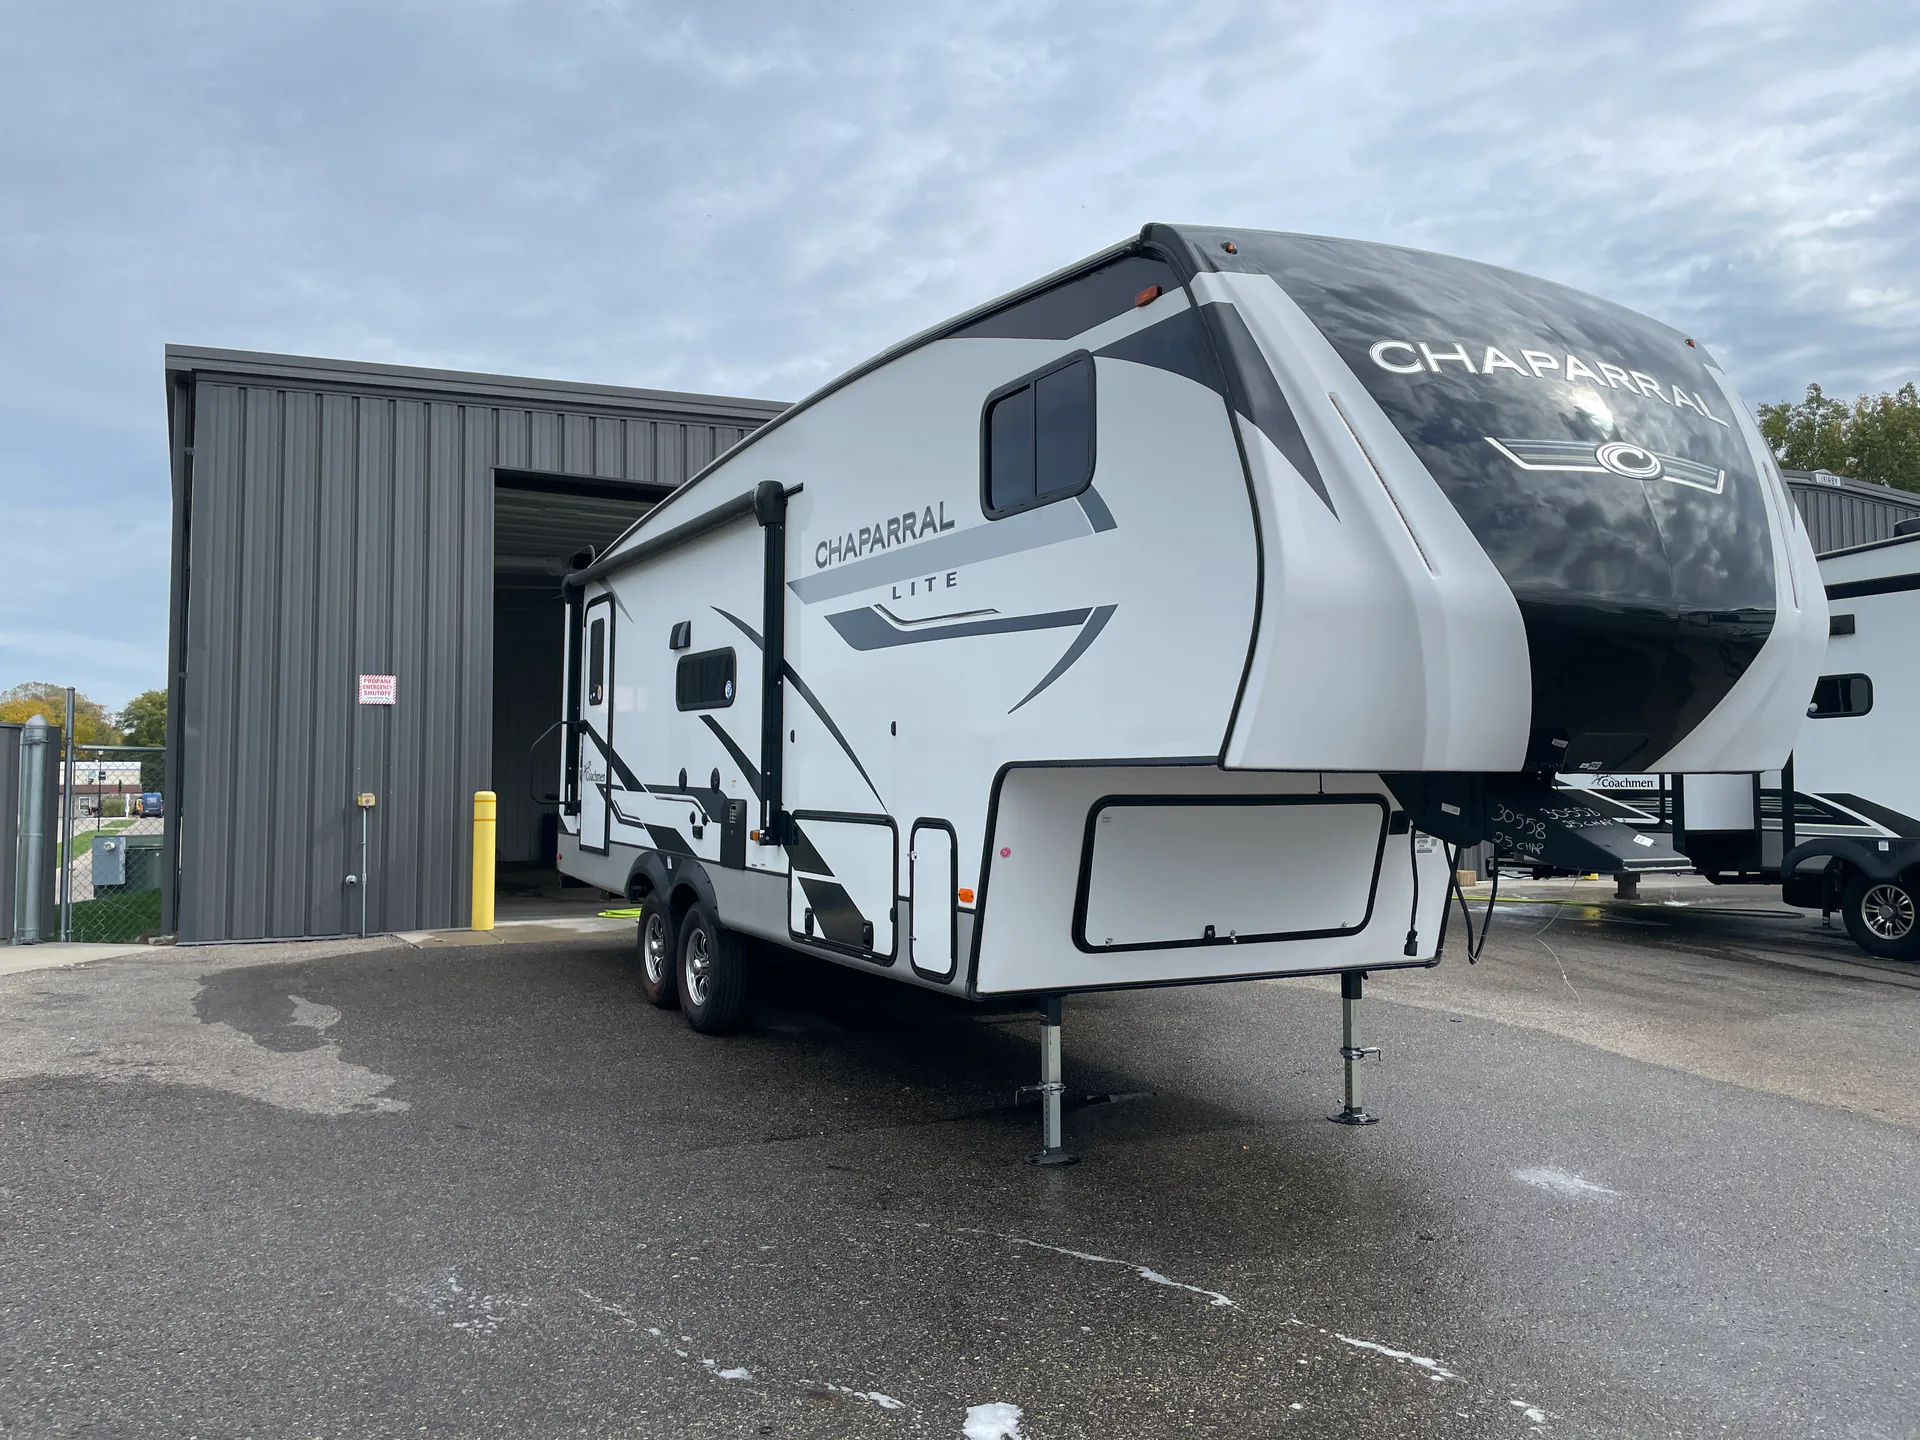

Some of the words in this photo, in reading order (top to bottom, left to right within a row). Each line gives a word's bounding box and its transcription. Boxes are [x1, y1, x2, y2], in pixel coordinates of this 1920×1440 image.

[1369, 339, 1731, 428] CHAPARRAL
[815, 500, 956, 569] CHAPARRAL
[892, 571, 958, 600] LITE
[1602, 777, 1654, 788] Coachmen
[1491, 804, 1547, 840] 30558
[1493, 831, 1513, 850] 25
[1516, 842, 1545, 855] CHAP
